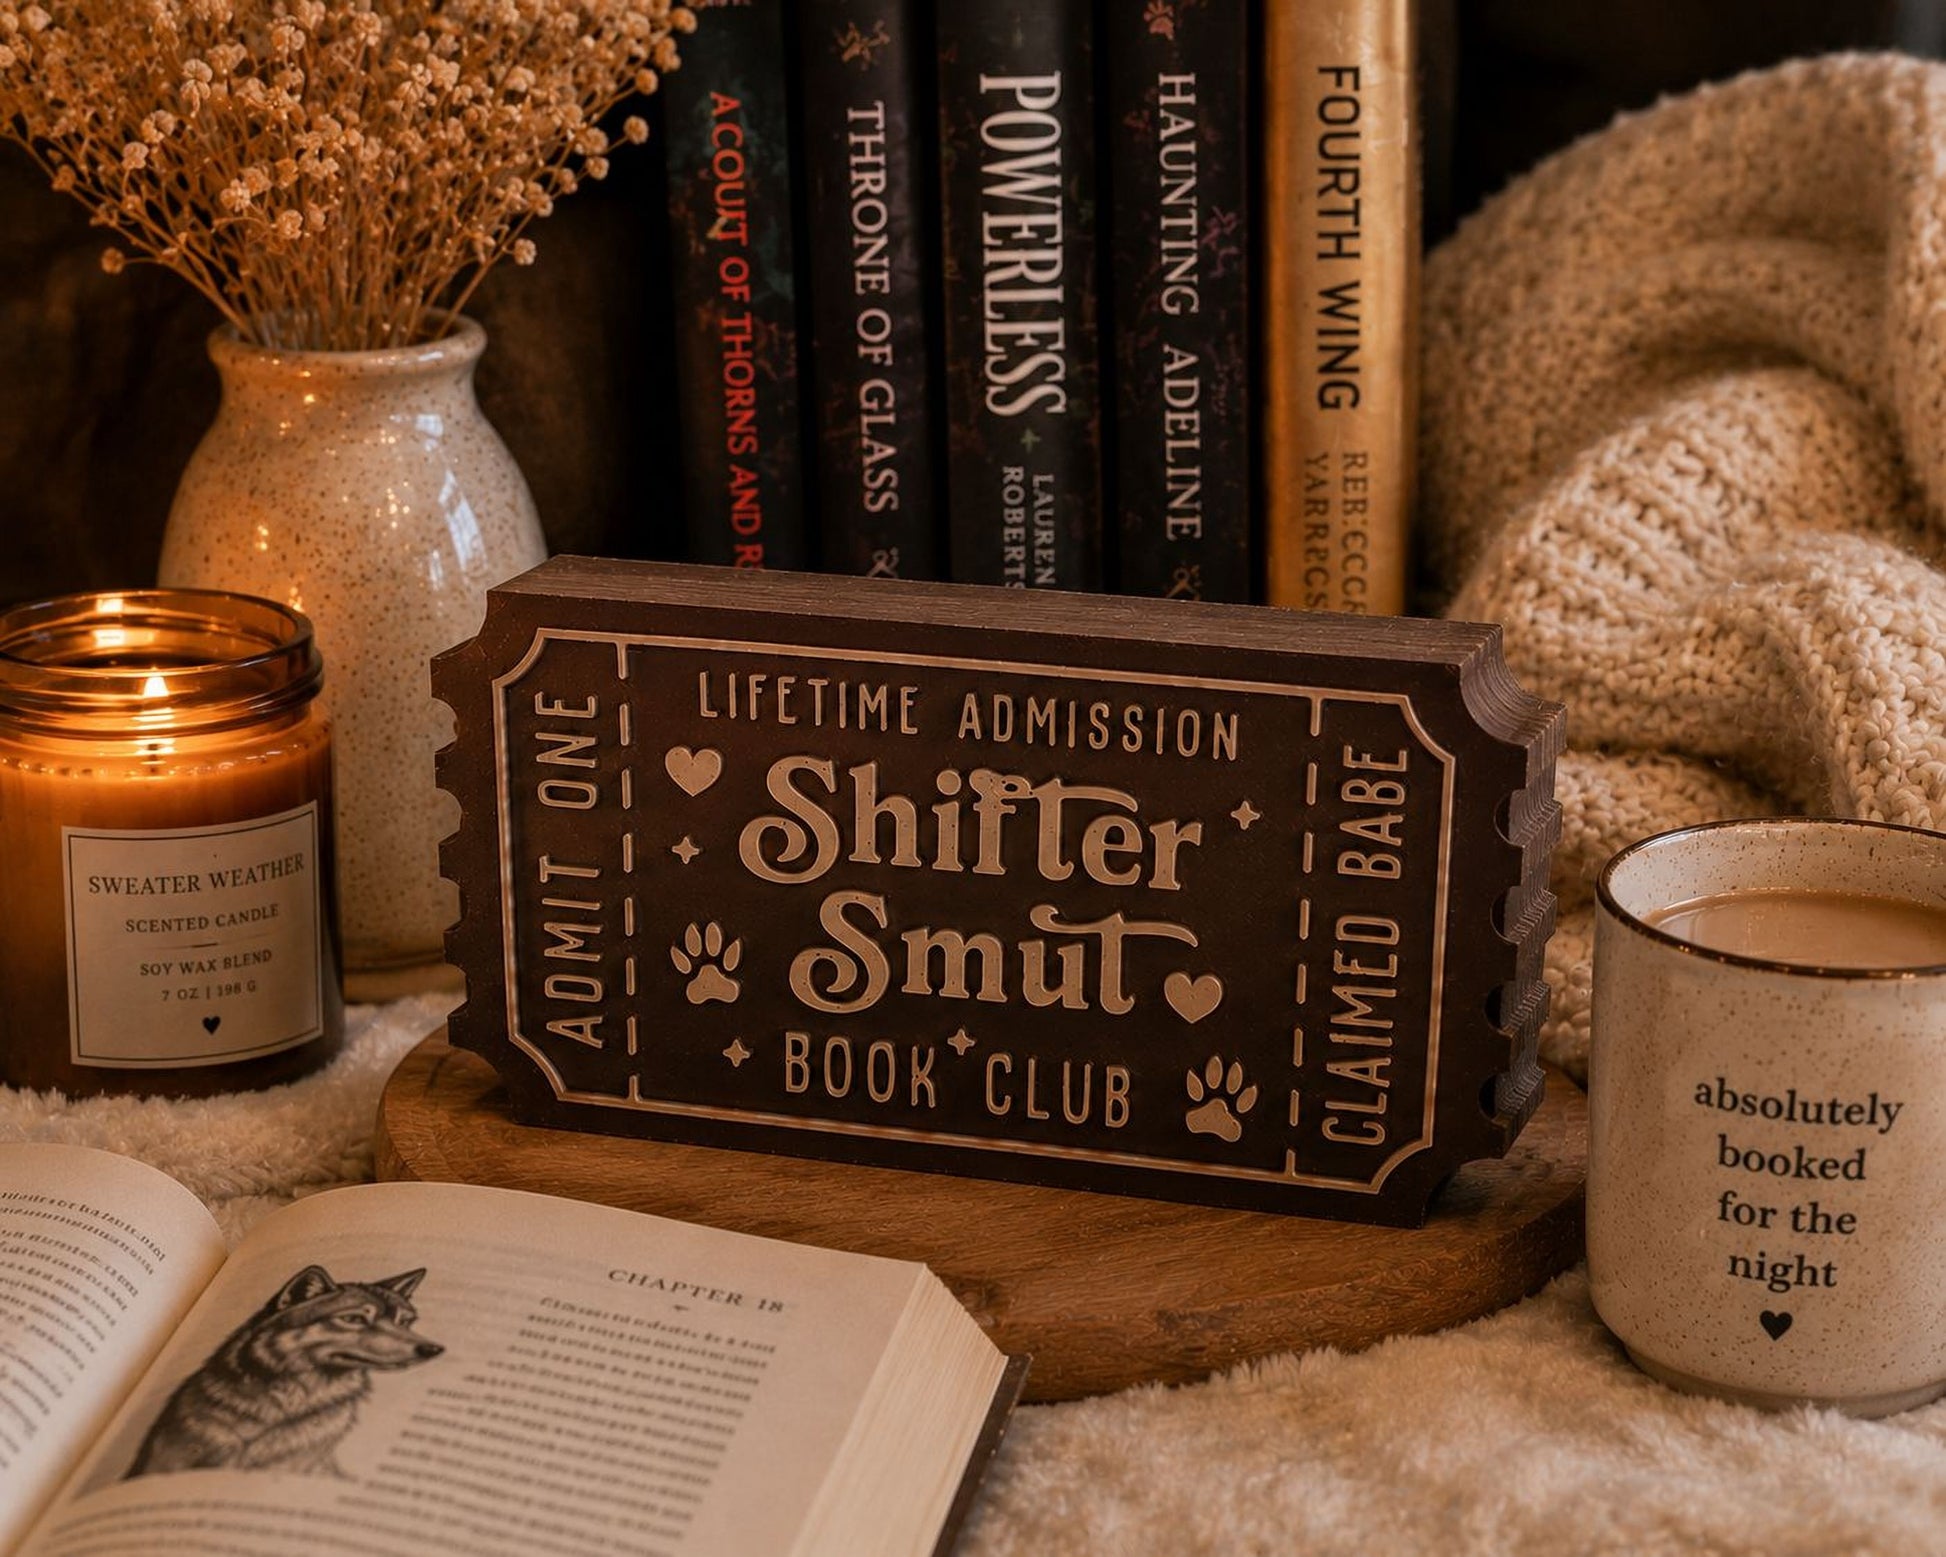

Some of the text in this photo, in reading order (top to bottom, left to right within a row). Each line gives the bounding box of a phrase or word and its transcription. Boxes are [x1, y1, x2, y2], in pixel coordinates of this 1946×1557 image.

[710, 91, 741, 117] A
[979, 70, 1067, 416] POWERLESS
[1317, 66, 1361, 411] FOURTH WING
[719, 256, 750, 303] OF
[847, 100, 898, 513] THRONE OF GLASS
[1158, 72, 1202, 542] HAUNTING ADELINE
[720, 312, 758, 456] THORNS
[729, 463, 762, 535] AND
[1032, 474, 1056, 584] LAUREN
[700, 671, 1240, 761] LIFETIME ADMISSION
[739, 755, 1202, 891] Shifter
[88, 852, 304, 895] SWEATER WEATHER
[534, 691, 604, 1049] ADMIT ONE
[125, 903, 280, 933] SCENTED CANDLE
[788, 890, 1199, 1015] Smut
[1321, 744, 1408, 1146] CLAIMED BABE
[140, 949, 273, 976] SOY WAX BLEND
[161, 989, 169, 1001] 7
[177, 987, 199, 1000] OZ
[247, 980, 257, 993] G
[785, 1031, 1131, 1128] BOOK CLUB
[1694, 1077, 1904, 1135] absolutely
[1717, 1133, 1867, 1181] booked
[1717, 1190, 1858, 1235] for the
[607, 1269, 744, 1307] CHAPTER
[1727, 1251, 1838, 1294] night
